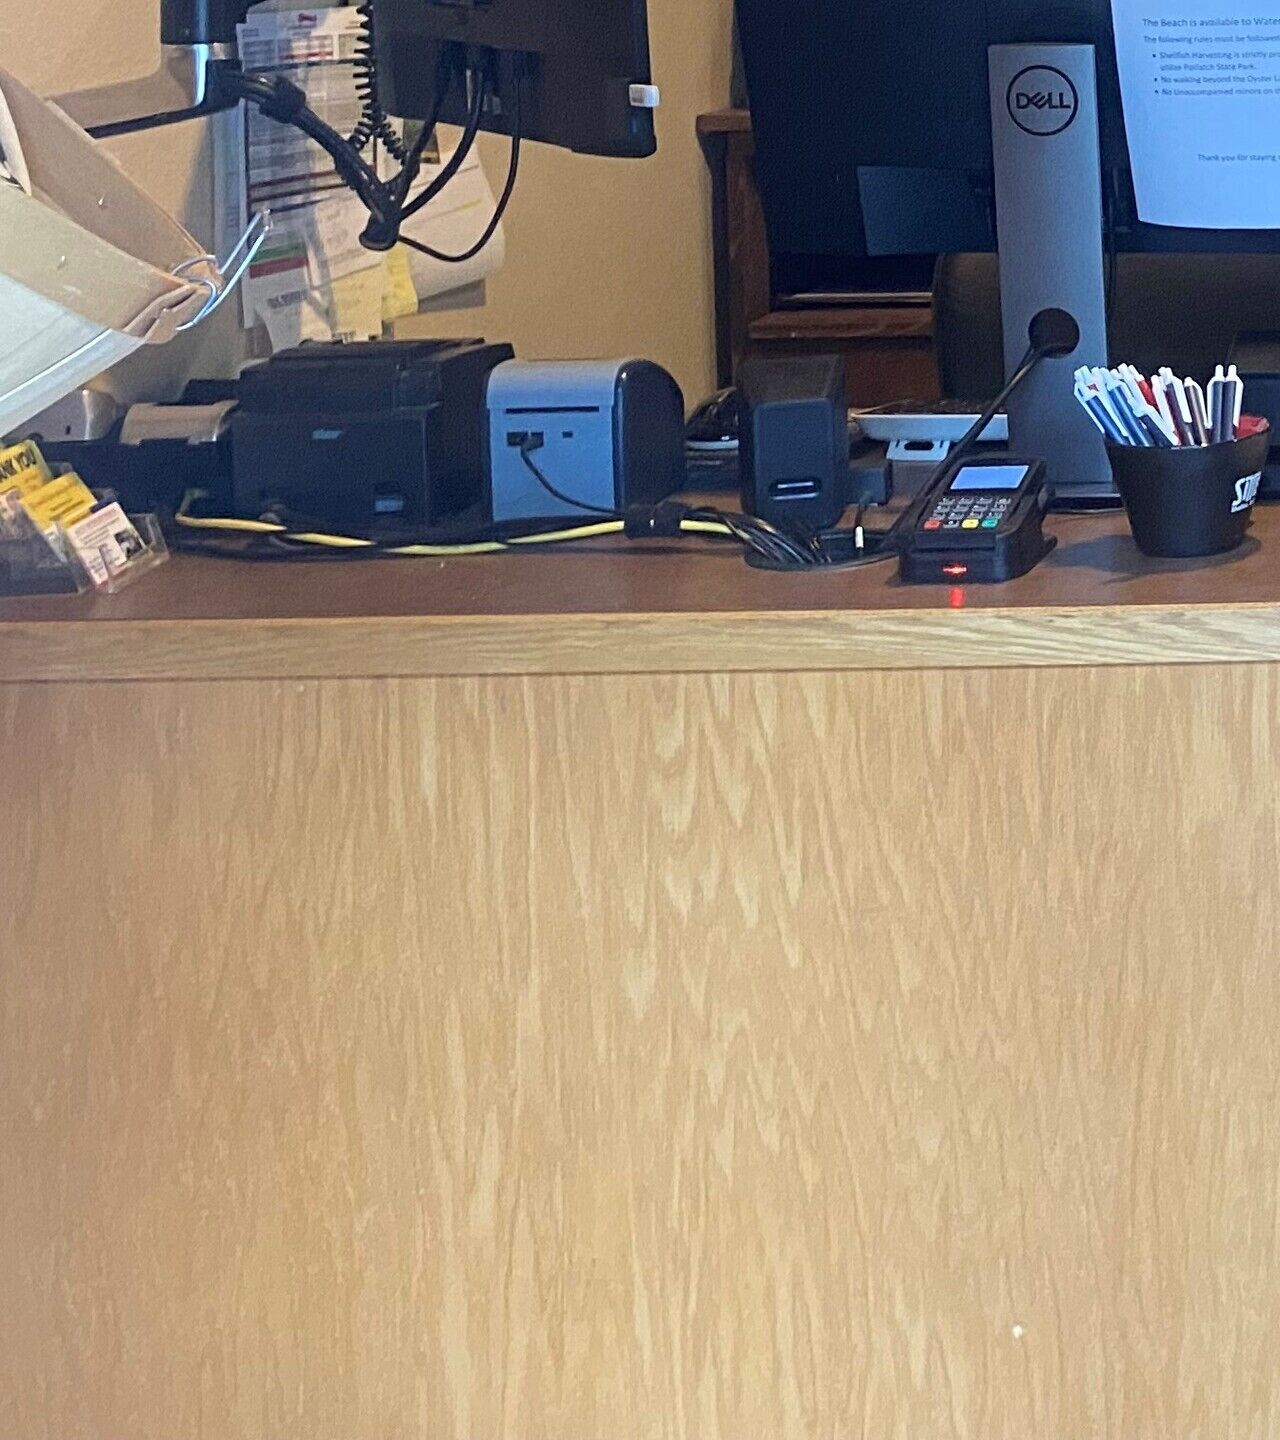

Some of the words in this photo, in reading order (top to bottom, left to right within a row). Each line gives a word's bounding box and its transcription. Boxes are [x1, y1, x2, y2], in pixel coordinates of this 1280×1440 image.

[1143, 18, 1158, 26] The
[1160, 18, 1187, 26] Beach
[1189, 18, 1197, 26] is
[1200, 17, 1239, 26] available
[1144, 35, 1156, 43] The
[1158, 35, 1192, 44] following
[1192, 51, 1232, 60] Harvesting
[1216, 63, 1236, 71] State
[1203, 75, 1231, 84] beyond
[1016, 92, 1071, 109] DELL
